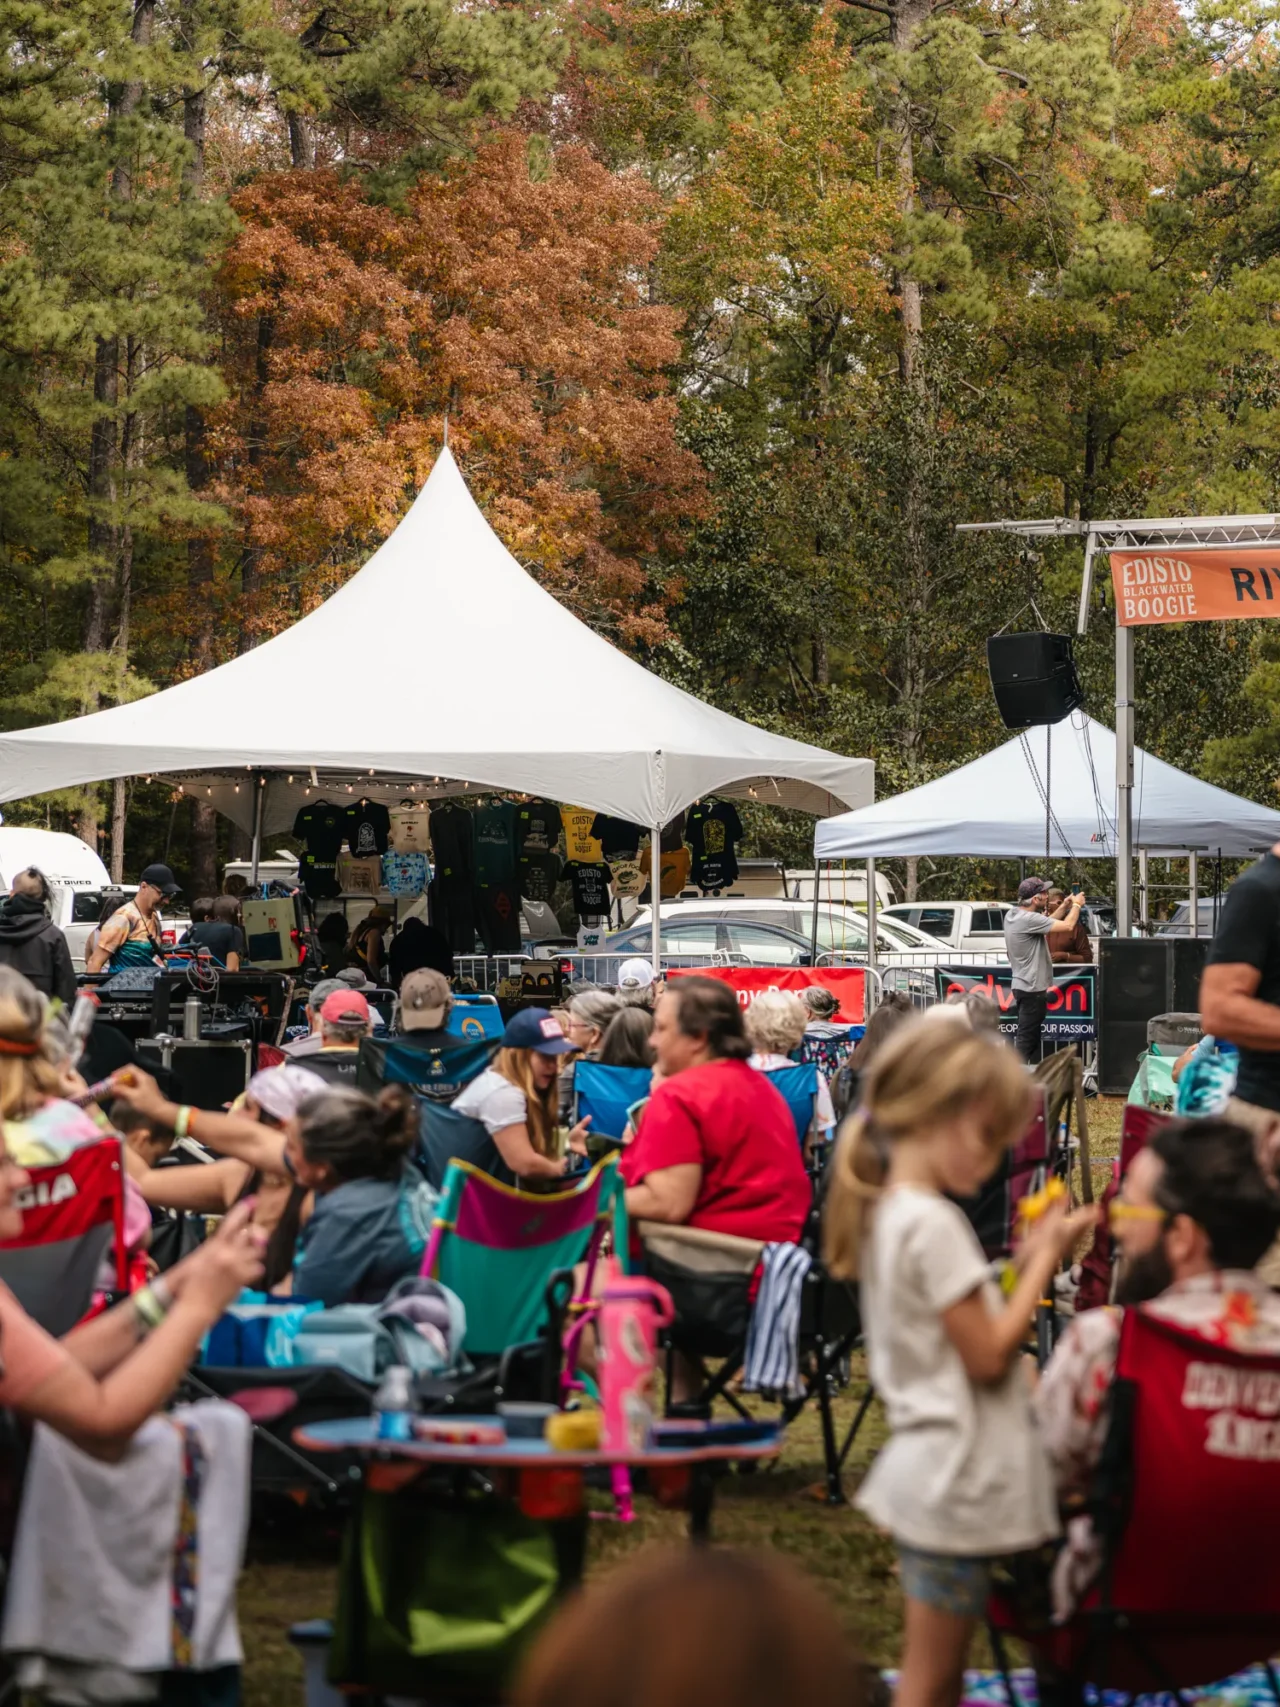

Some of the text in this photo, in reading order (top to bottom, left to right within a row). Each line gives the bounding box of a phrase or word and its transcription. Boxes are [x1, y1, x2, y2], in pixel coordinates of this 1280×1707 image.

[1122, 556, 1192, 586] EDISTO
[1123, 583, 1194, 597] BLACKWATER
[1124, 595, 1197, 619] BOOGIE
[1059, 1023, 1094, 1035] PASSION
